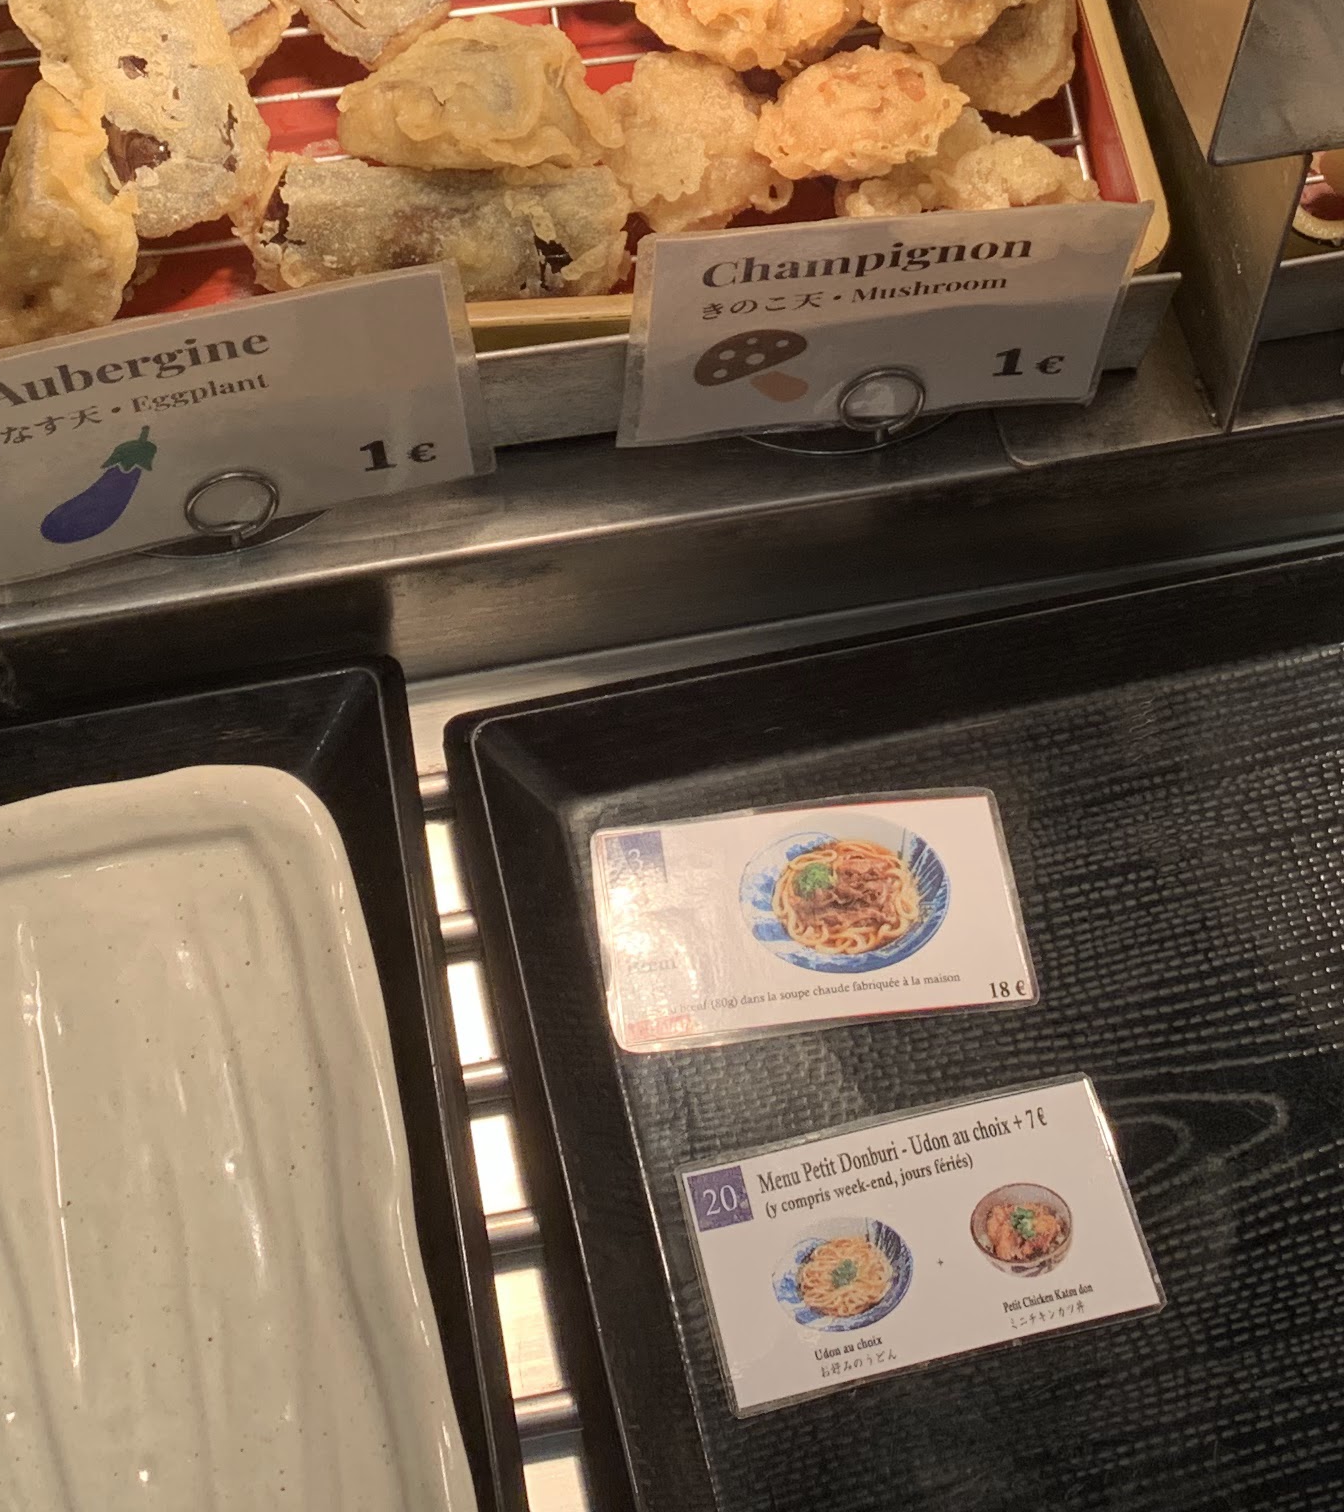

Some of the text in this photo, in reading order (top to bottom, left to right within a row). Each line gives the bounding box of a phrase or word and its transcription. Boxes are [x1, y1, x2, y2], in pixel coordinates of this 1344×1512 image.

[702, 238, 1034, 289] Champignon
[850, 274, 1008, 304] Mushroom
[131, 372, 270, 415] Eggplant
[740, 992, 766, 1007] dans
[766, 990, 778, 1002] la
[779, 988, 811, 1002] soupe
[812, 982, 851, 998] chaude
[851, 977, 901, 995] fabriquée
[902, 976, 910, 987] à
[910, 975, 922, 987] la
[922, 972, 961, 986] maison
[756, 1170, 801, 1195] Menu
[801, 1157, 838, 1184] Petit
[839, 1140, 901, 1175] Donburi
[910, 1131, 951, 1158] Udon
[952, 1129, 972, 1146] au
[973, 1116, 1012, 1141] choix
[702, 1183, 740, 1217] 20
[764, 1152, 974, 1219] (y compris week-end, jours fériés)
[1002, 1300, 1023, 1314] Petit
[1021, 1292, 1055, 1309] Chicken
[1077, 1283, 1094, 1296] don
[814, 1335, 883, 1361] Udon au choix
